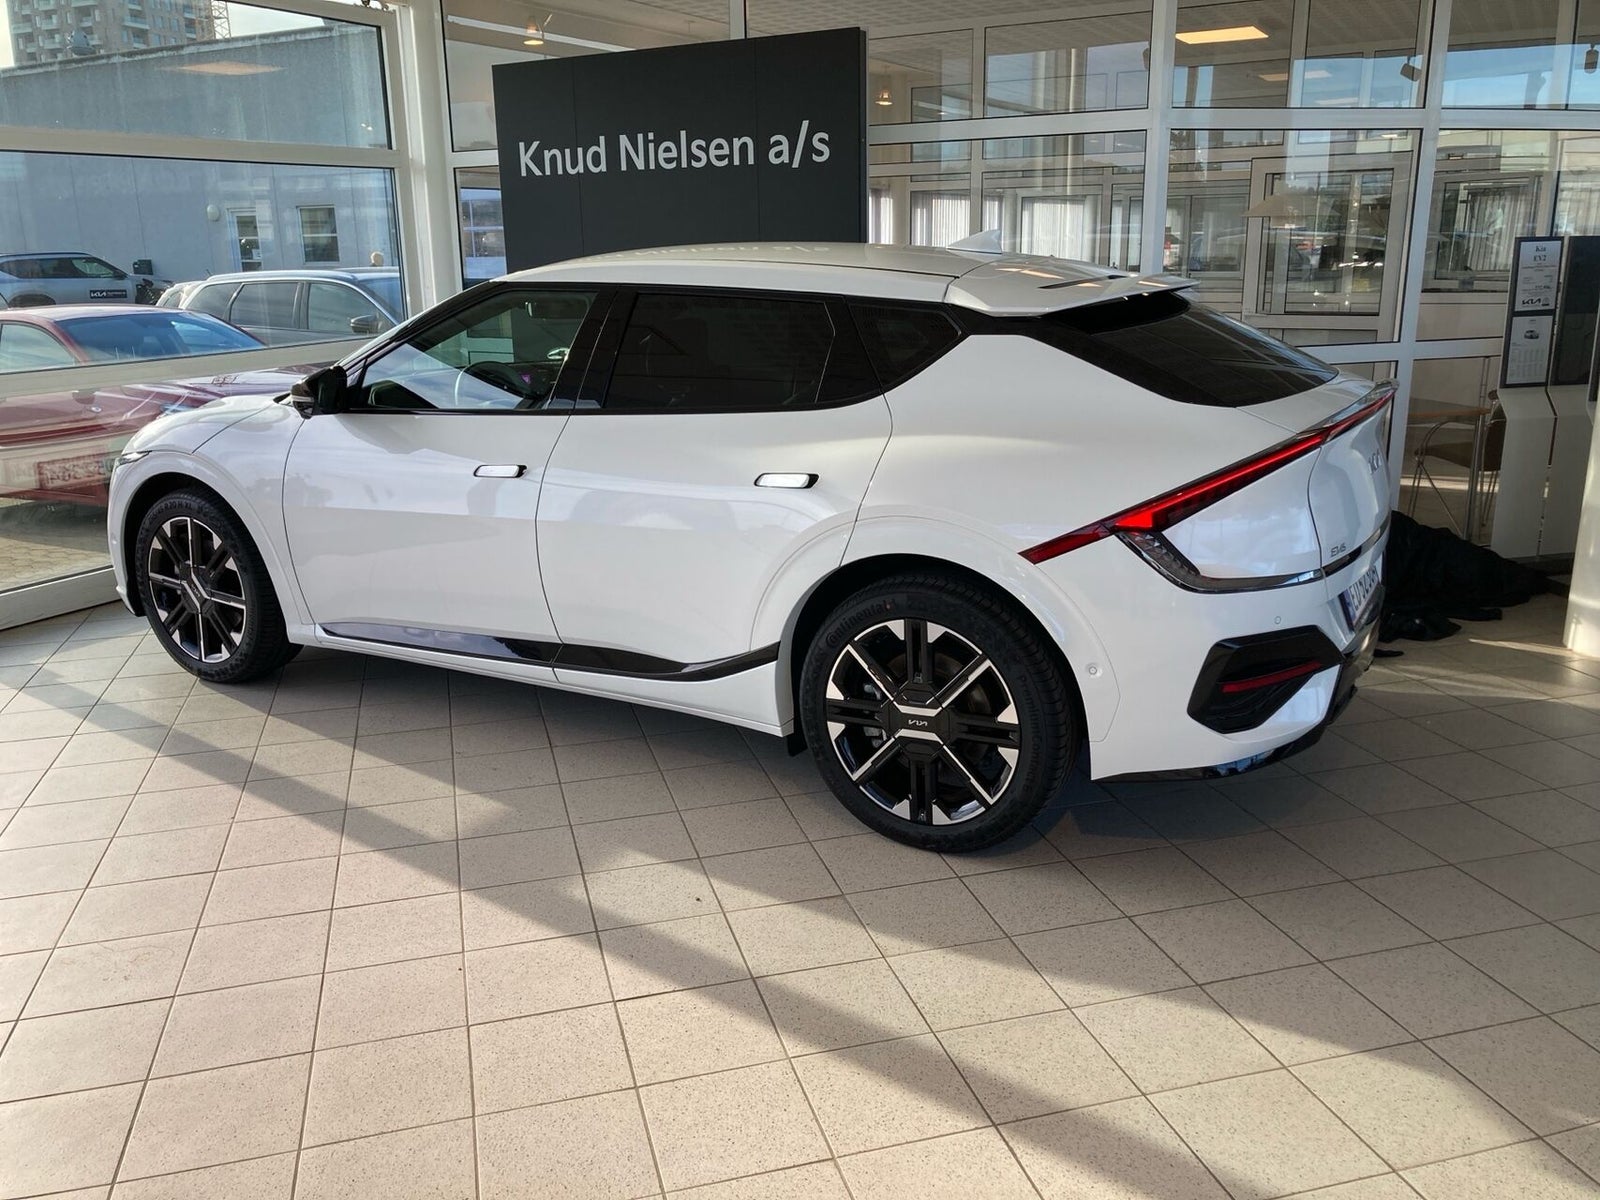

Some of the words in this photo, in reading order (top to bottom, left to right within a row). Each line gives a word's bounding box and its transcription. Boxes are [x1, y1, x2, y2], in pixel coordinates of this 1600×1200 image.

[518, 136, 607, 177] Knud
[618, 130, 755, 172] Nielsen
[768, 119, 831, 169] a/s
[1330, 542, 1347, 557] EV6
[825, 600, 891, 648] Continental
